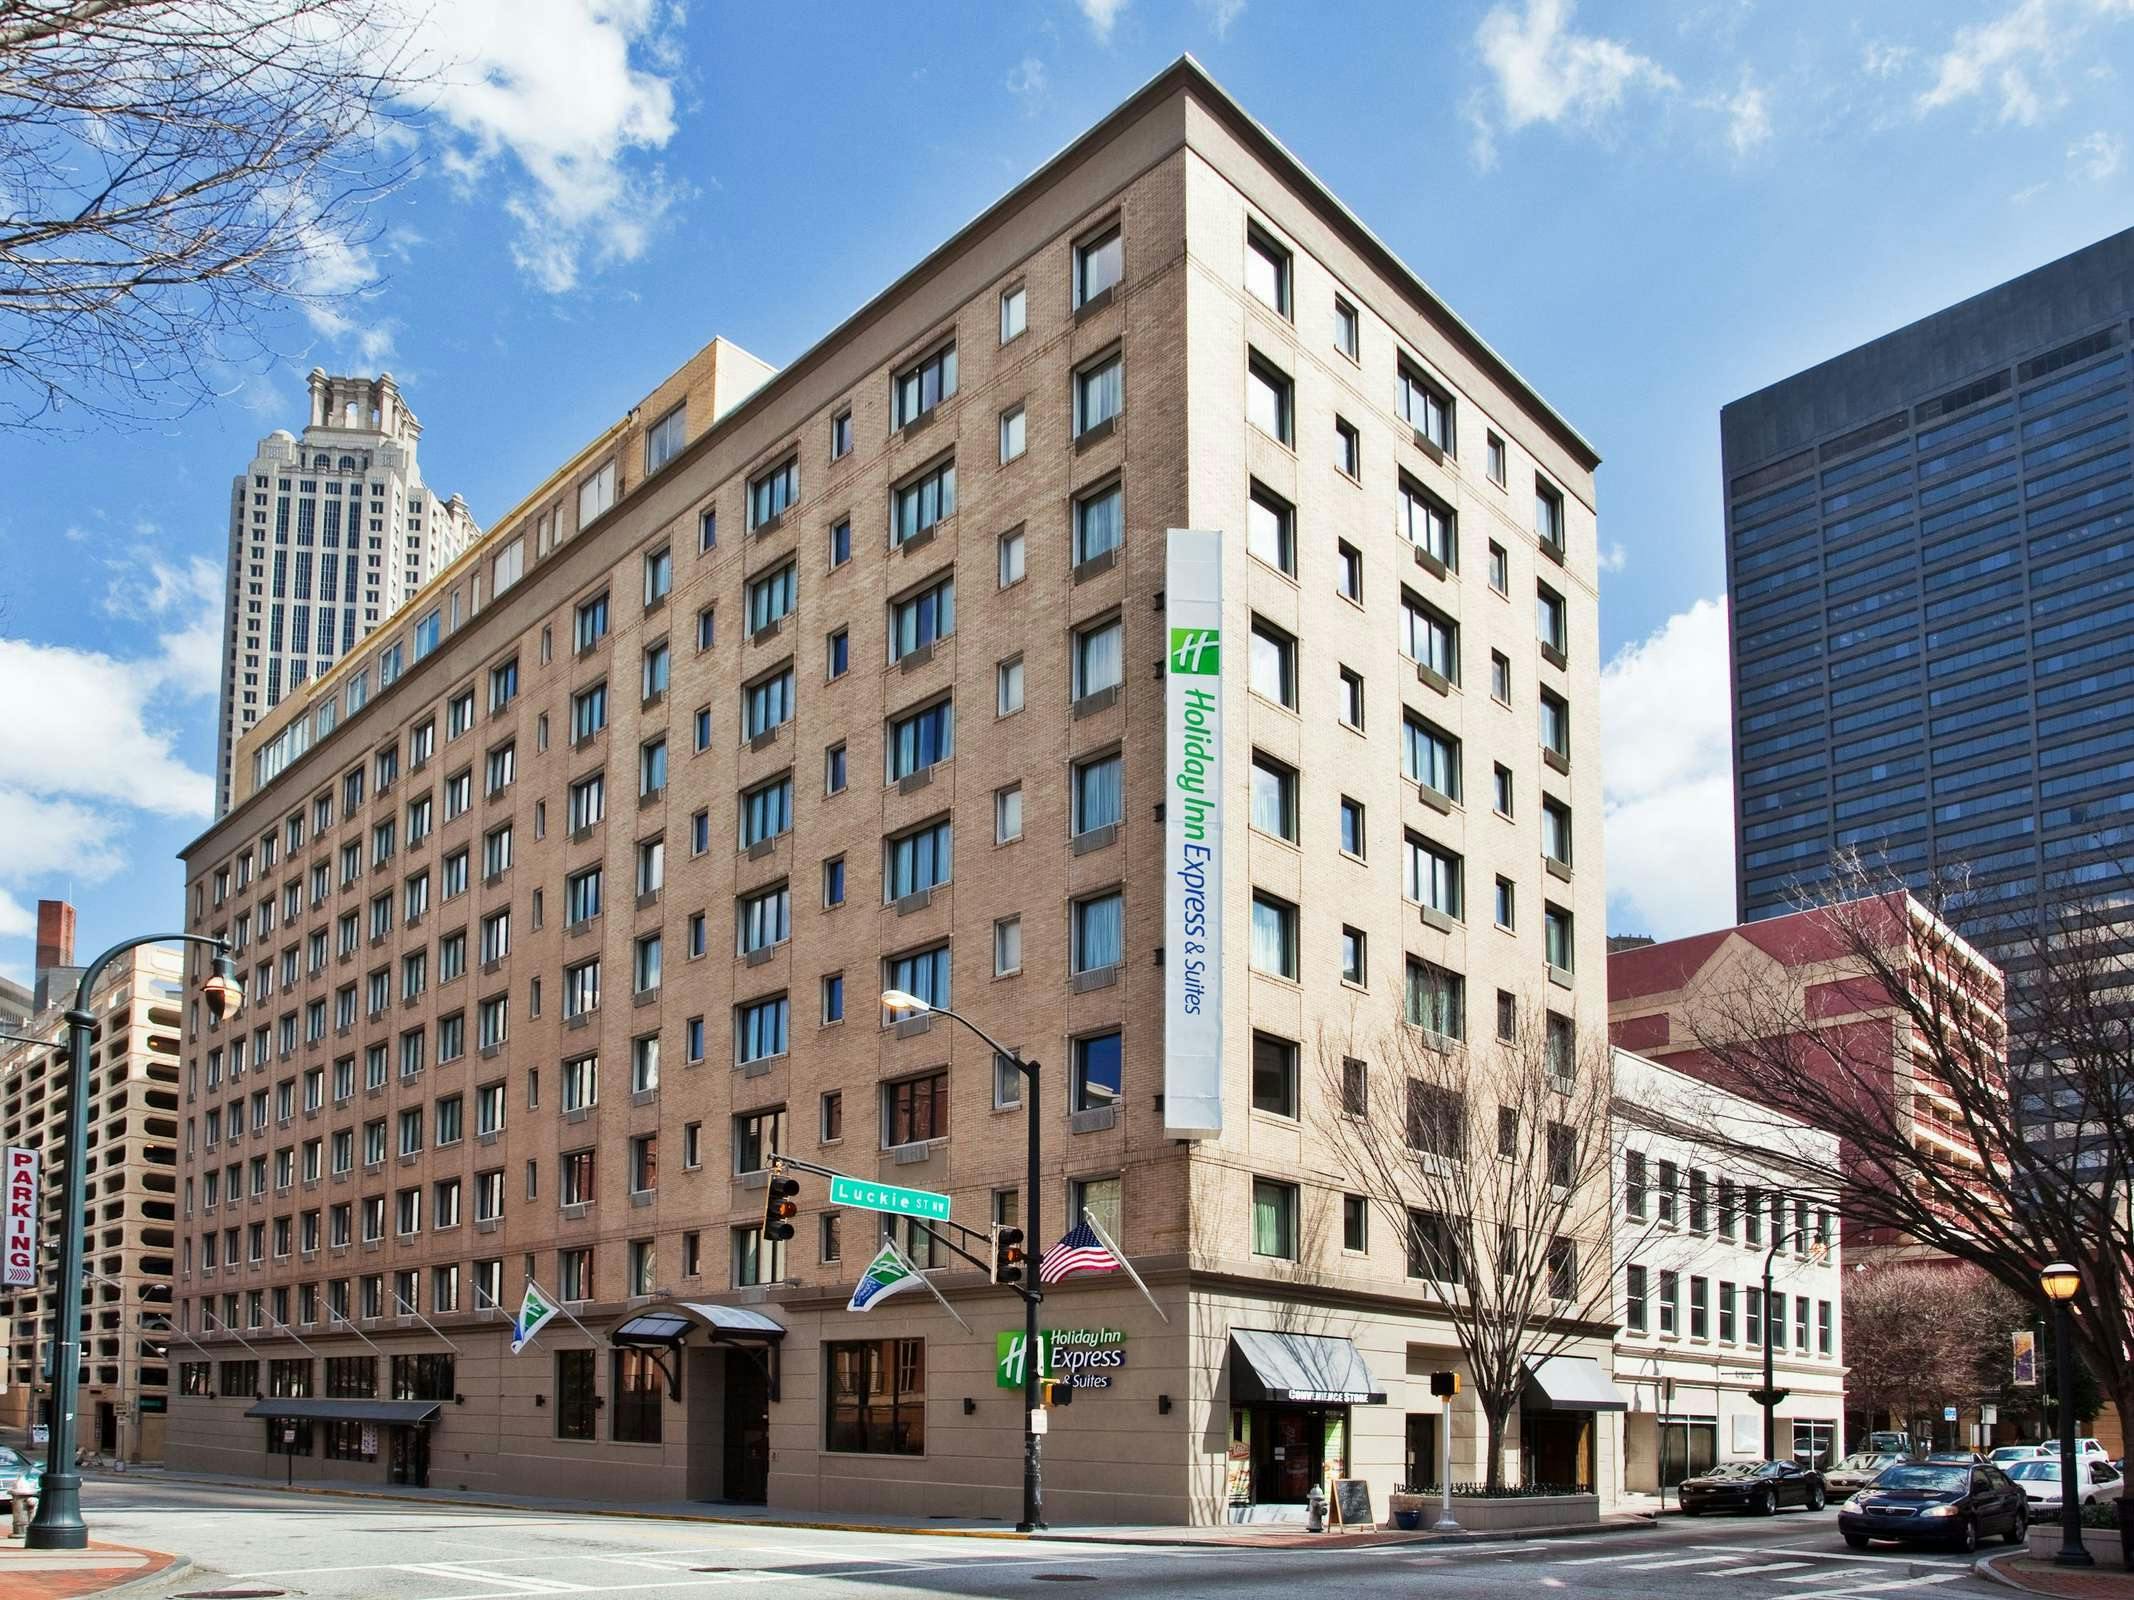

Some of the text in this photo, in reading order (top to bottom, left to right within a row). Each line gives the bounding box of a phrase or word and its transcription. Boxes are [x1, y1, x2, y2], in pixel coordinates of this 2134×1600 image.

[1176, 688, 1216, 1015] Holiday Inn Express & Suites
[10, 1153, 33, 1268] PARKING
[838, 1183, 944, 1213] Luckie ST NW
[1050, 1327, 1121, 1347] Holiday Inn
[1051, 1346, 1121, 1373] Express
[1062, 1374, 1108, 1388] & Suites
